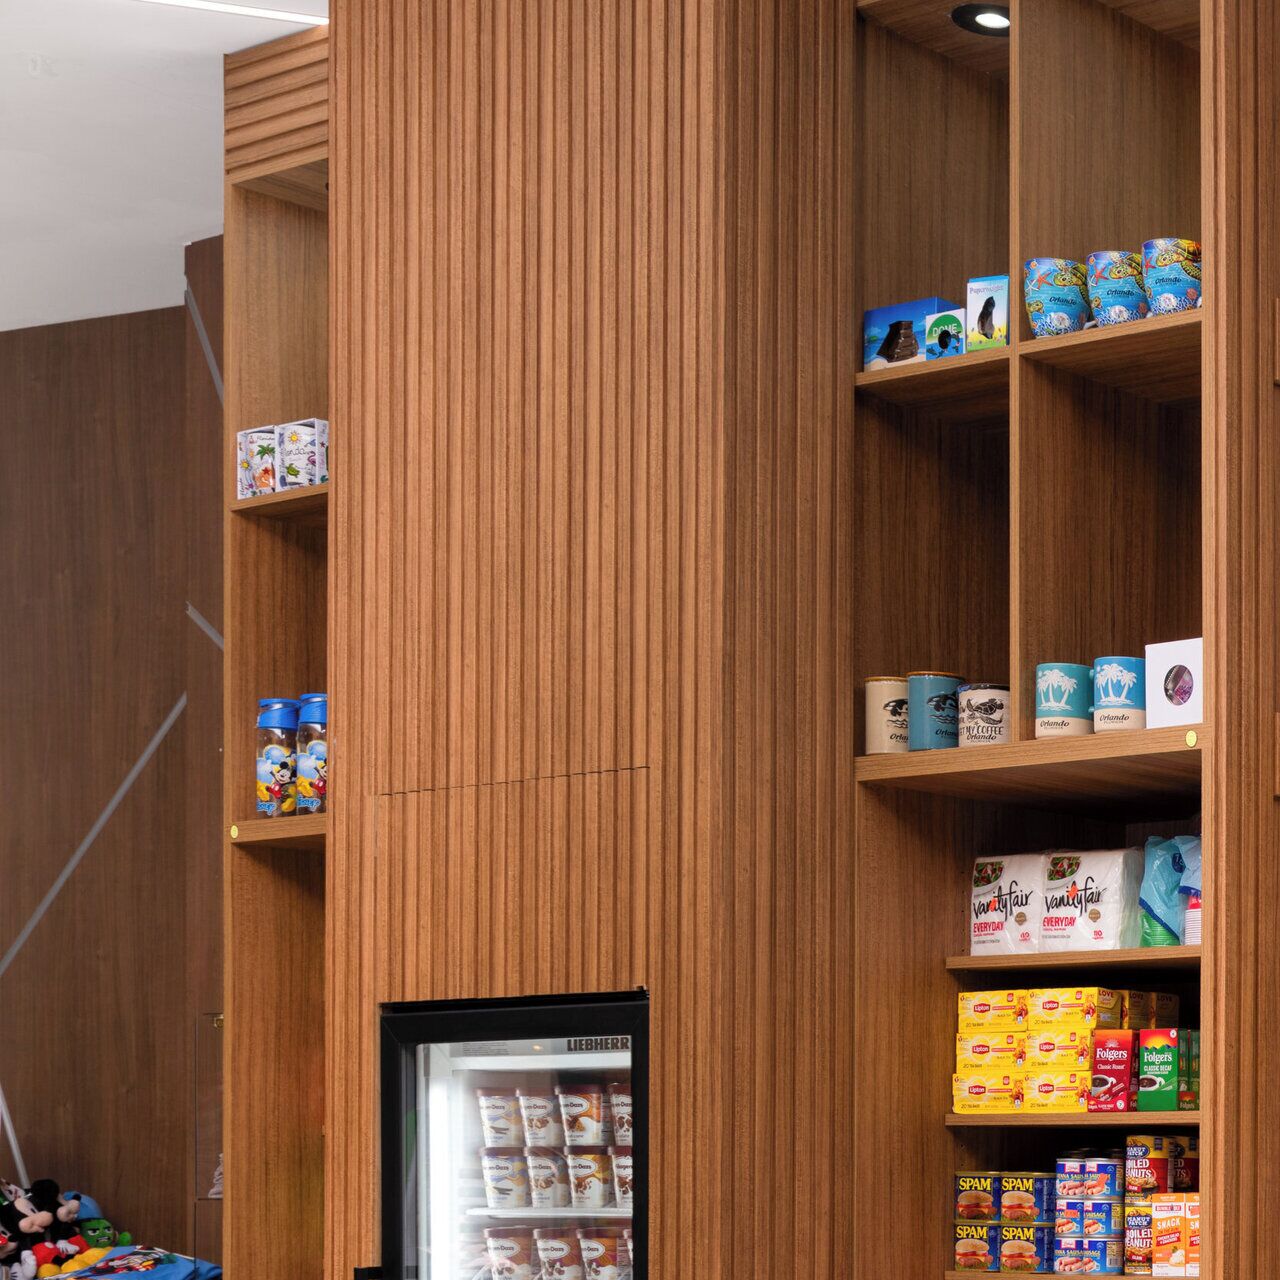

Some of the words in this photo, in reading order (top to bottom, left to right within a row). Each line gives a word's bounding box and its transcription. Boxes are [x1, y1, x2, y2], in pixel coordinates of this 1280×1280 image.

[1154, 276, 1182, 285] Orlando
[969, 284, 1005, 294] Paperweight
[1106, 288, 1135, 297] Orlando
[1049, 295, 1077, 306] Orlando
[932, 320, 958, 336] DOME
[1039, 720, 1070, 728] Orlando
[1099, 714, 1130, 723] Orlando
[966, 726, 975, 736] MY
[976, 725, 1003, 736] COFFEE
[966, 733, 997, 741] Orlando
[973, 921, 1004, 932] EVERYDAY
[1042, 916, 1076, 927] EVERYDAY
[1099, 990, 1114, 998] LOVE
[567, 1037, 629, 1051] LIEBHERR
[1096, 1048, 1127, 1061] Folgers
[1144, 1052, 1172, 1064] Folgers
[959, 1178, 991, 1190] SPAM
[1002, 1178, 1033, 1191] SPAM
[1157, 1218, 1180, 1229] SNACK
[956, 1226, 987, 1238] SPAM
[1002, 1227, 1035, 1240] SPAM
